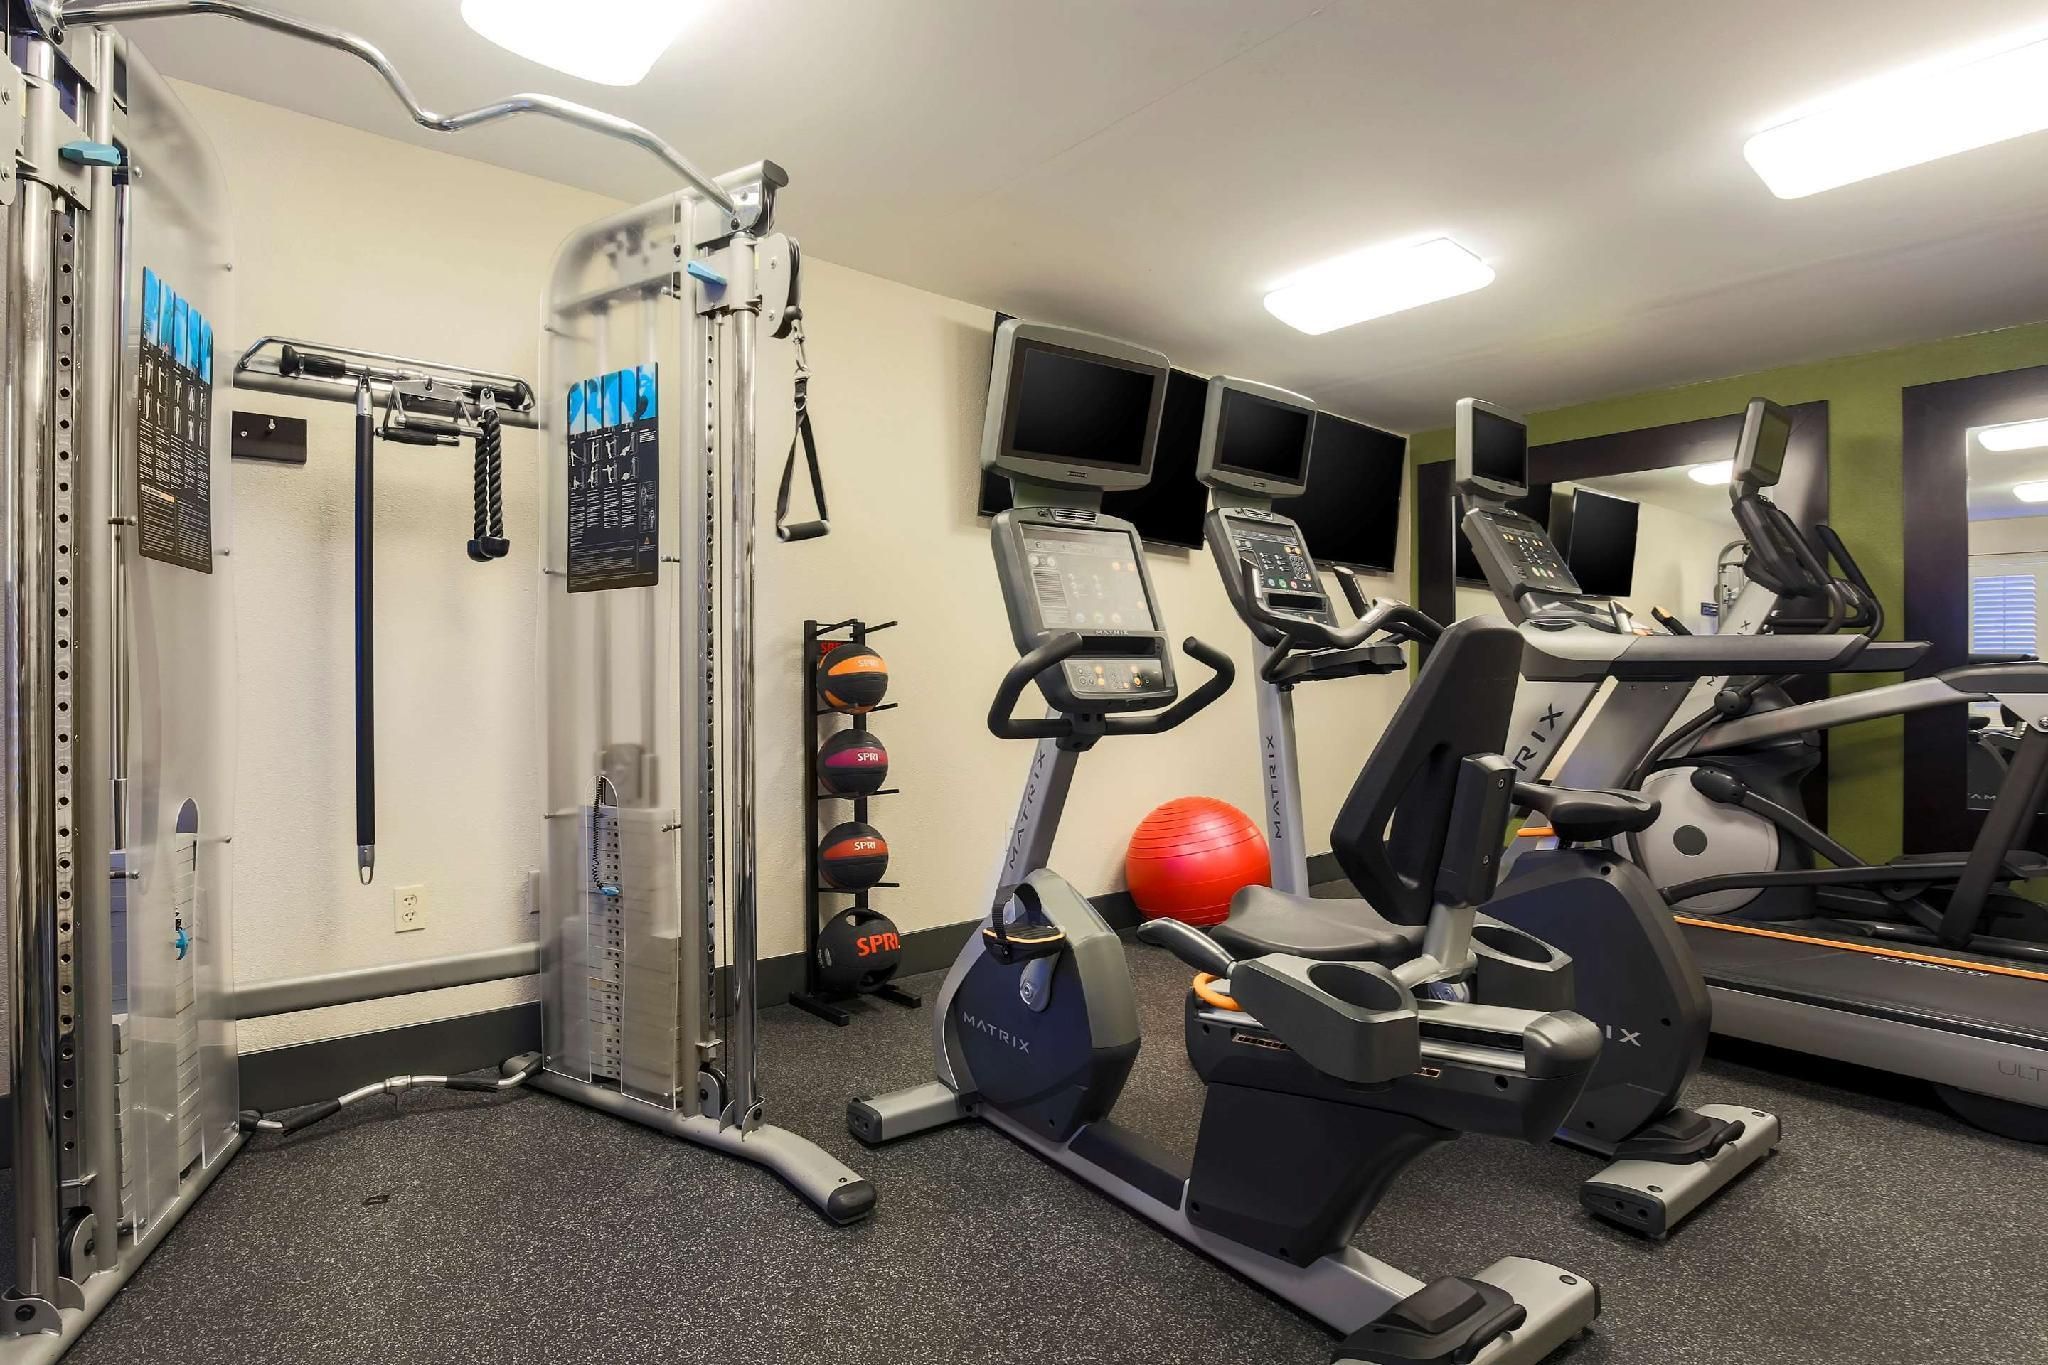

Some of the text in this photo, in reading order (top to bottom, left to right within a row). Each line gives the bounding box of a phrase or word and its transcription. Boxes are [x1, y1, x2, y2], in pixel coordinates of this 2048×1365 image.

[857, 752, 879, 763] SPRI
[1512, 702, 1564, 772] RIX
[1266, 735, 1282, 839] MATRIX
[1009, 750, 1047, 870] MATRIX
[854, 841, 876, 851] SPRI
[856, 932, 899, 957] SPRI
[963, 1011, 1031, 1055] MATRIX
